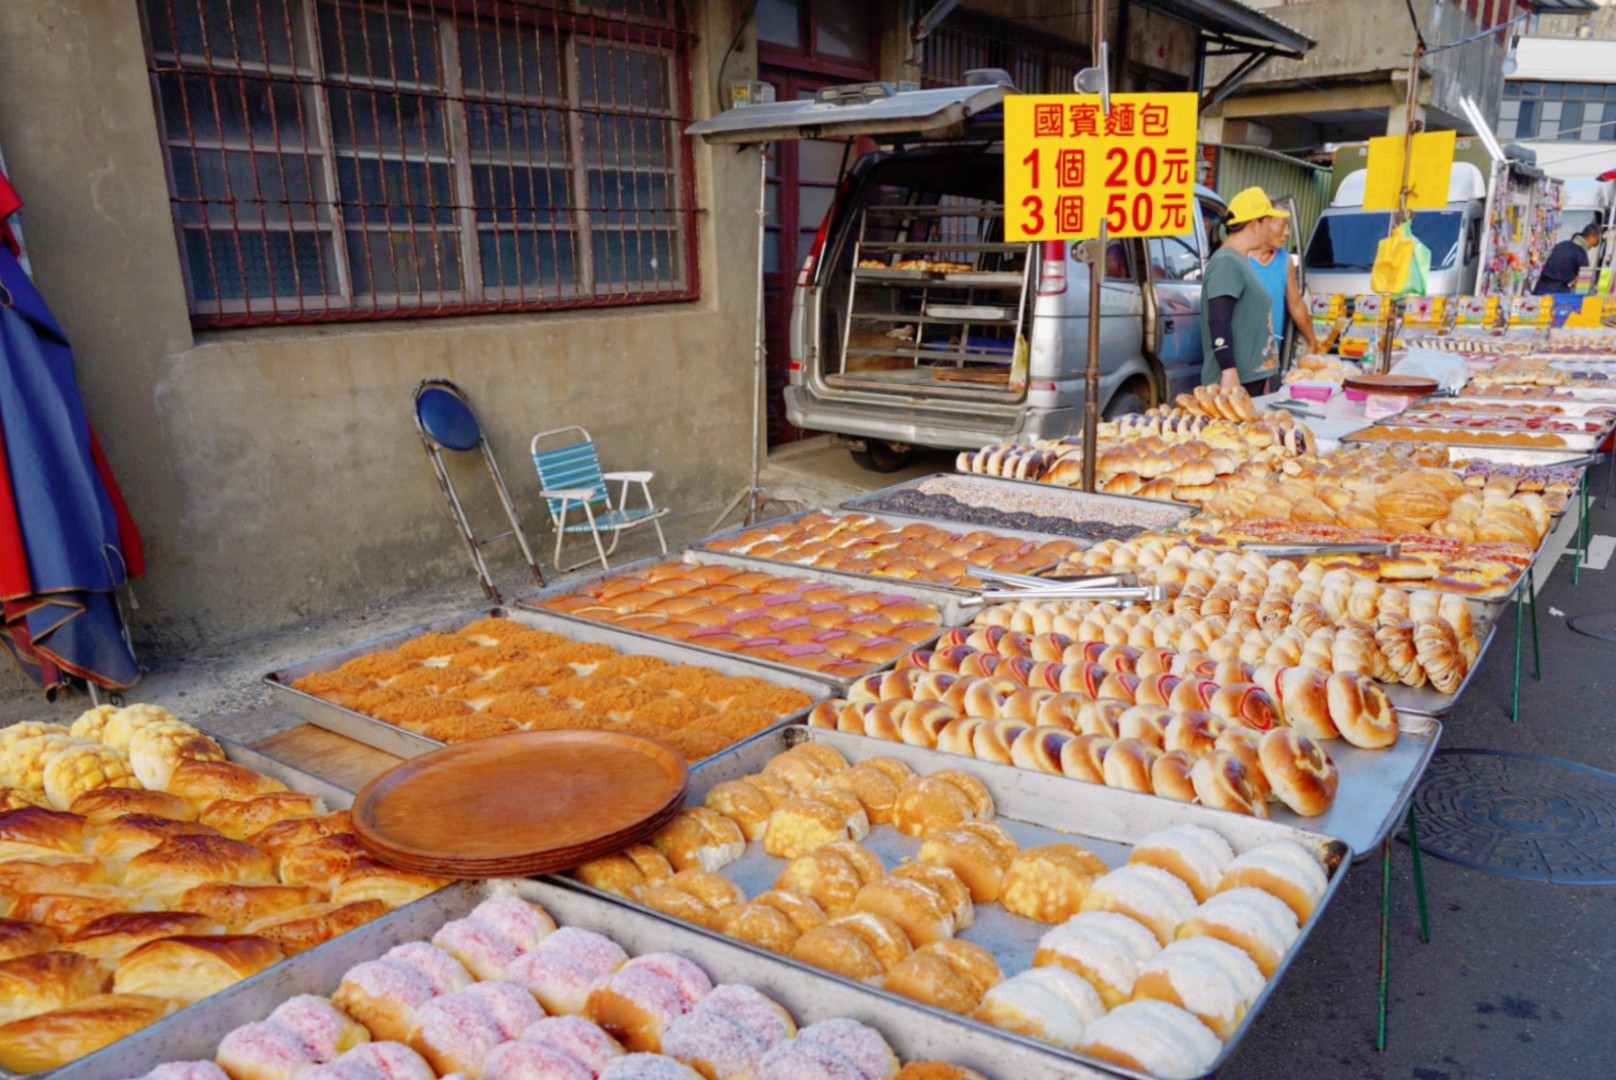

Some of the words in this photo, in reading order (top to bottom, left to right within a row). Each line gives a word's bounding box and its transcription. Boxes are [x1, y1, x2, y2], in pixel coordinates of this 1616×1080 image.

[1034, 102, 1169, 138] 國賓麵包
[1022, 147, 1085, 189] 1個
[1104, 146, 1190, 188] 20元
[1020, 194, 1084, 235] 3個
[1106, 192, 1188, 233] 50元
